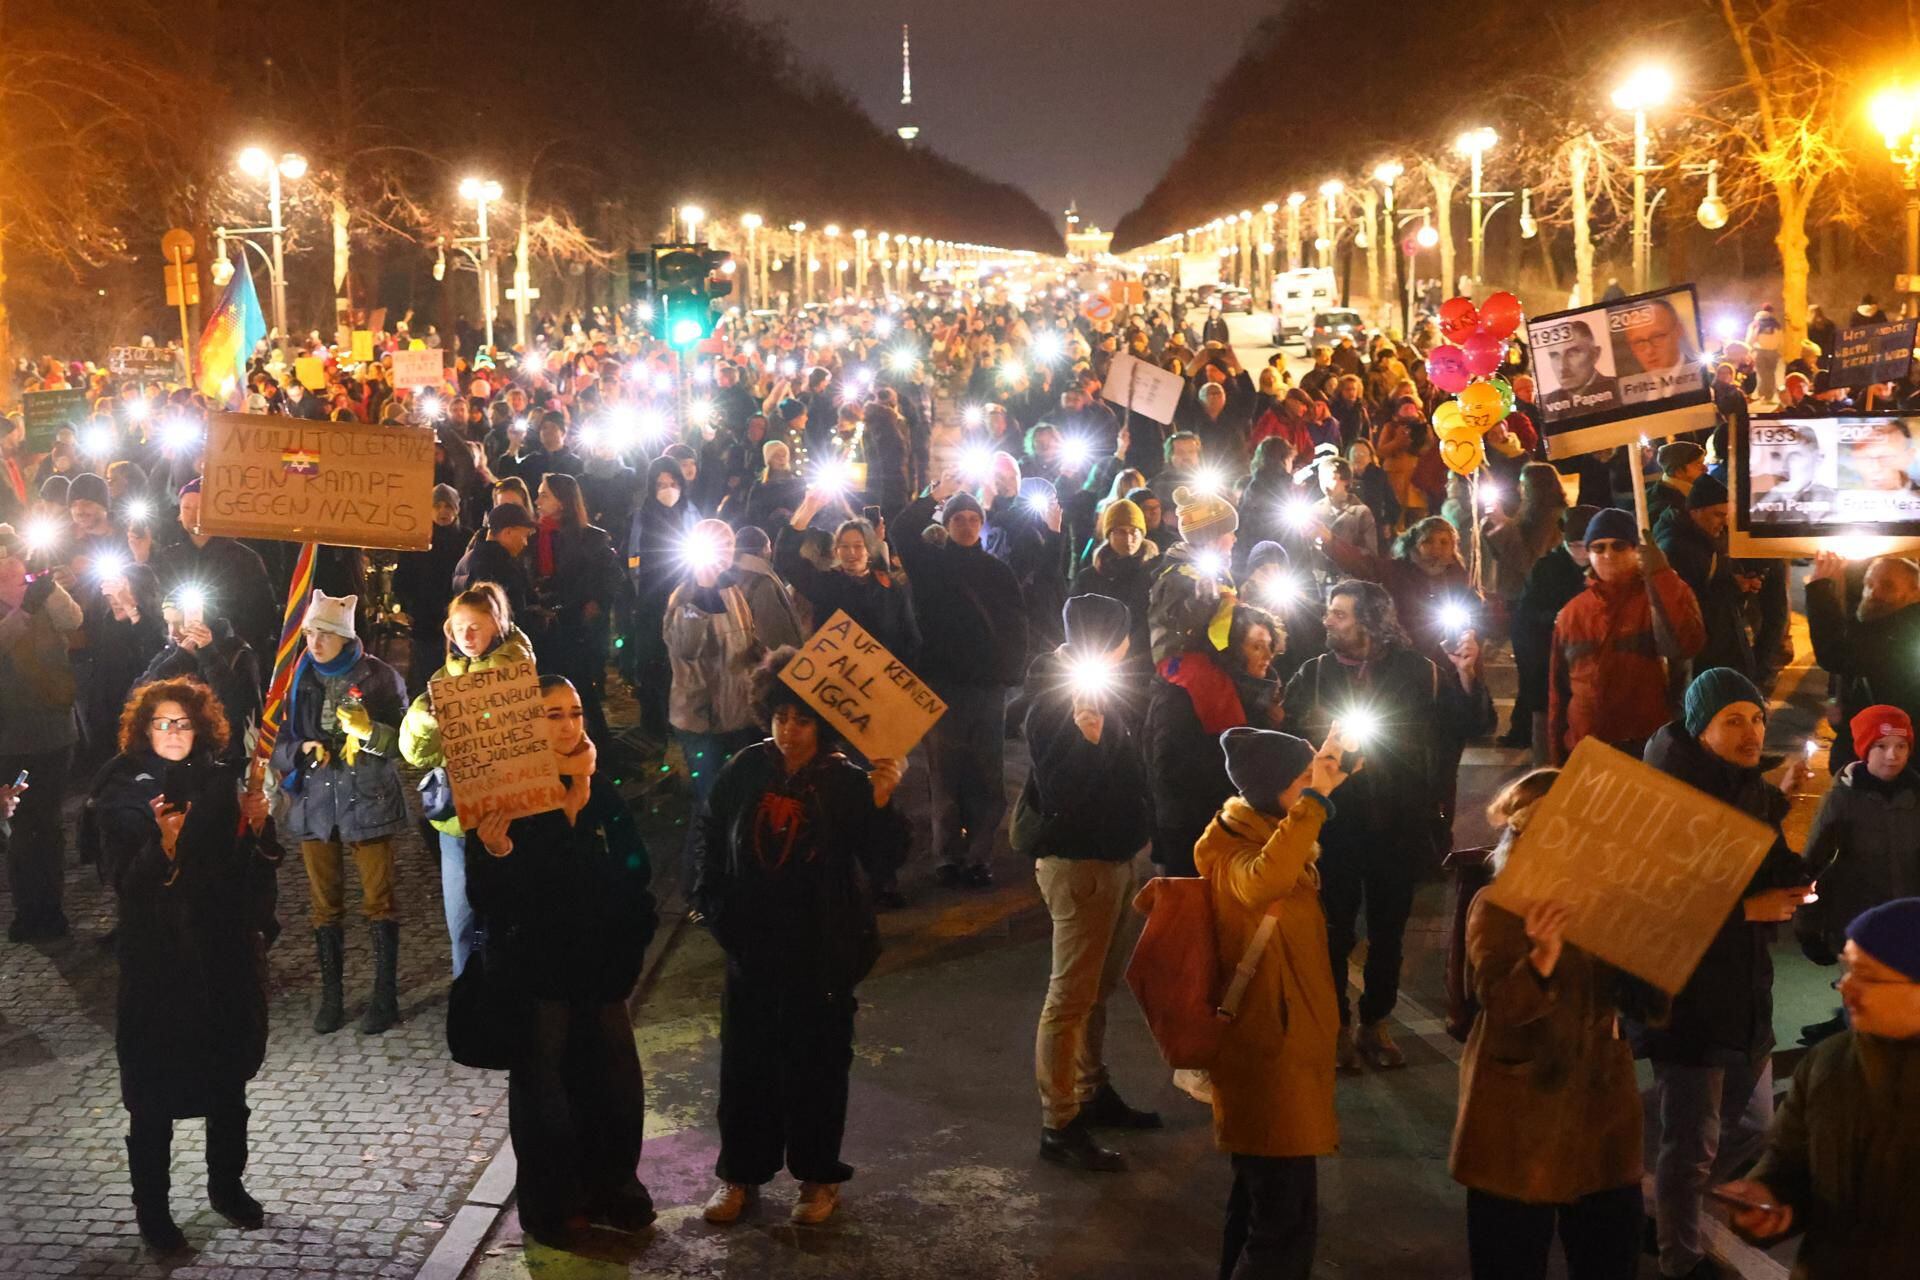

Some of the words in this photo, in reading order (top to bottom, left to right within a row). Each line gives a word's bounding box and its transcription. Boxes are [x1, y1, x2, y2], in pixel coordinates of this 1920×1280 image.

[1611, 308, 1652, 328] 2025
[1531, 325, 1572, 345] 1933
[1624, 379, 1657, 396] Fritz
[1659, 372, 1697, 388] Merz
[1547, 398, 1572, 412] von
[1573, 391, 1613, 407] Papen
[1755, 428, 1797, 443] 1933
[215, 465, 288, 490] MEIN
[304, 469, 404, 496] KAMPF
[215, 490, 309, 516] GEGEN
[318, 498, 417, 532] NAZIS
[496, 662, 532, 682] NUR
[812, 638, 875, 700] FALL
[828, 620, 881, 654] AUF
[883, 660, 942, 715] KEINEN
[791, 657, 872, 733] DIGGA
[441, 721, 473, 740] KEIN
[1560, 763, 1678, 849] MUTTI
[1536, 814, 1591, 861] DU
